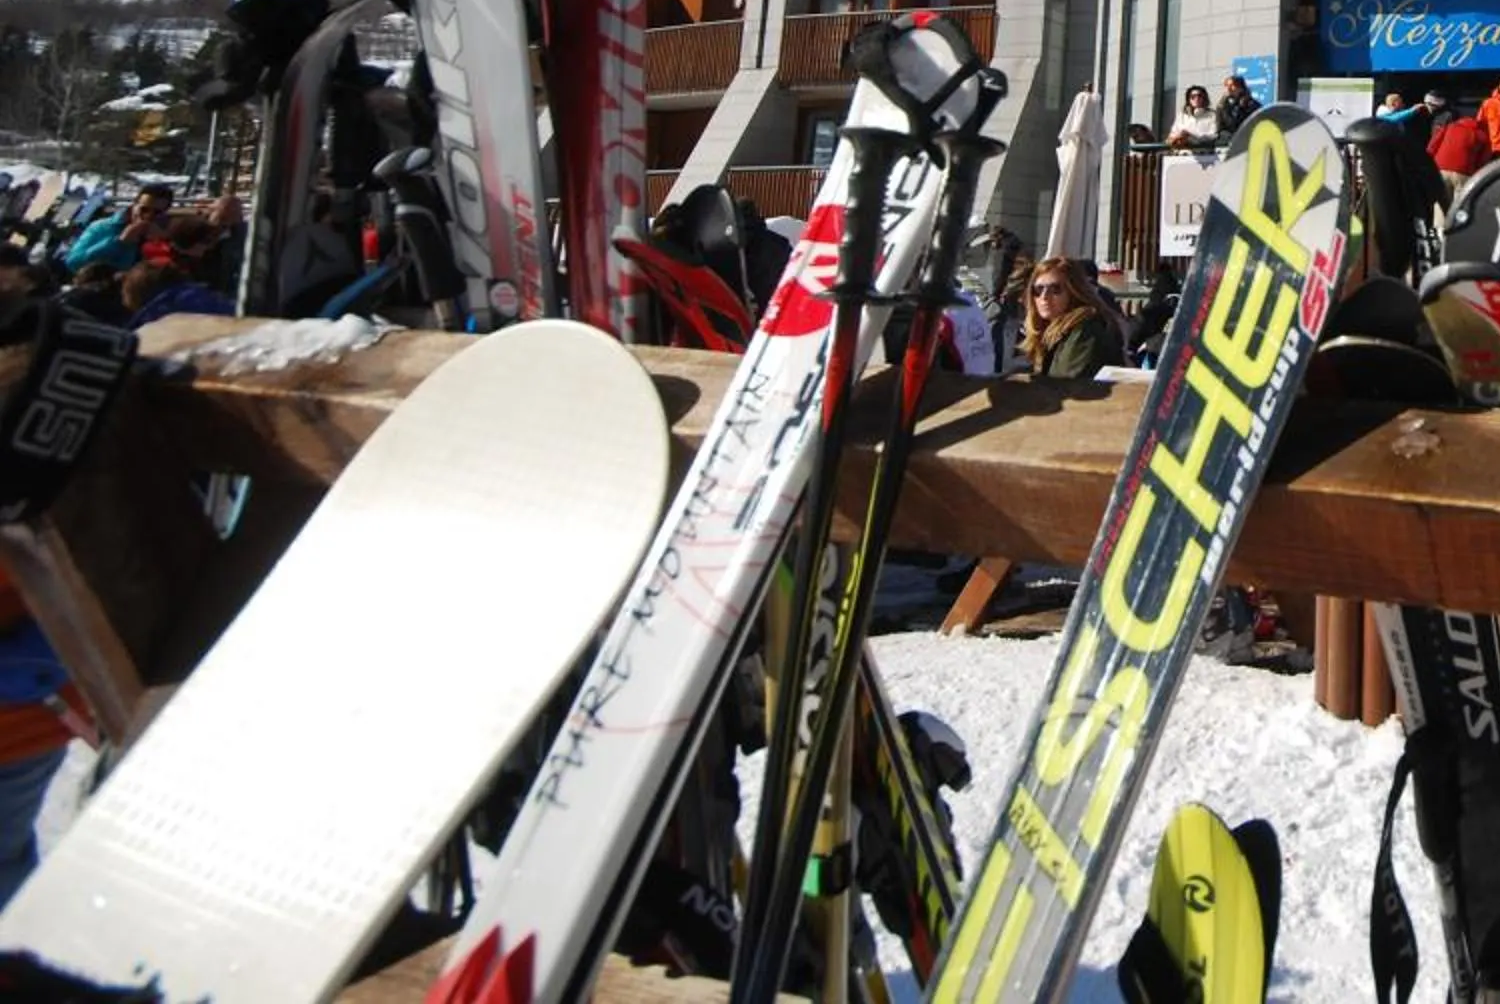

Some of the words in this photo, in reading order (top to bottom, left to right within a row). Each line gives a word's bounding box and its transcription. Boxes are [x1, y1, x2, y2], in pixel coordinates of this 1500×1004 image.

[1300, 230, 1346, 341] SL
[12, 306, 135, 461] TUS
[1200, 326, 1301, 587] worldcup
